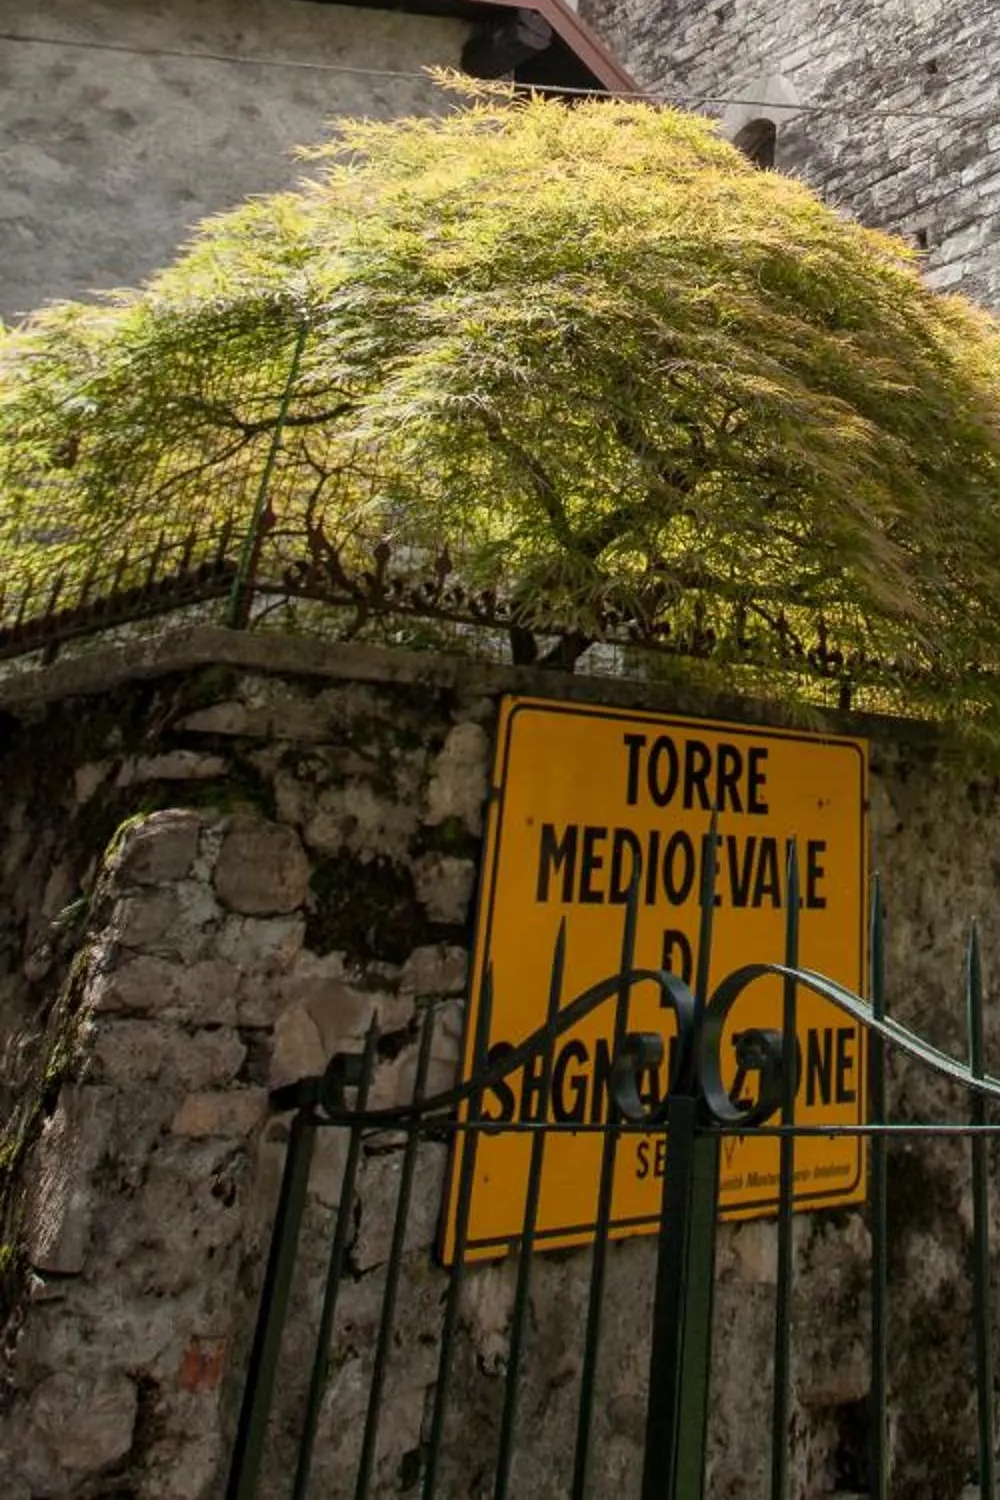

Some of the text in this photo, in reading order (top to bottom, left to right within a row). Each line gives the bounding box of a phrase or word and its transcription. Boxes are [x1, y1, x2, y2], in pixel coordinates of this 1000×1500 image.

[624, 733, 769, 815] TORRE
[658, 929, 700, 1008] D
[635, 1139, 672, 1178] SE
